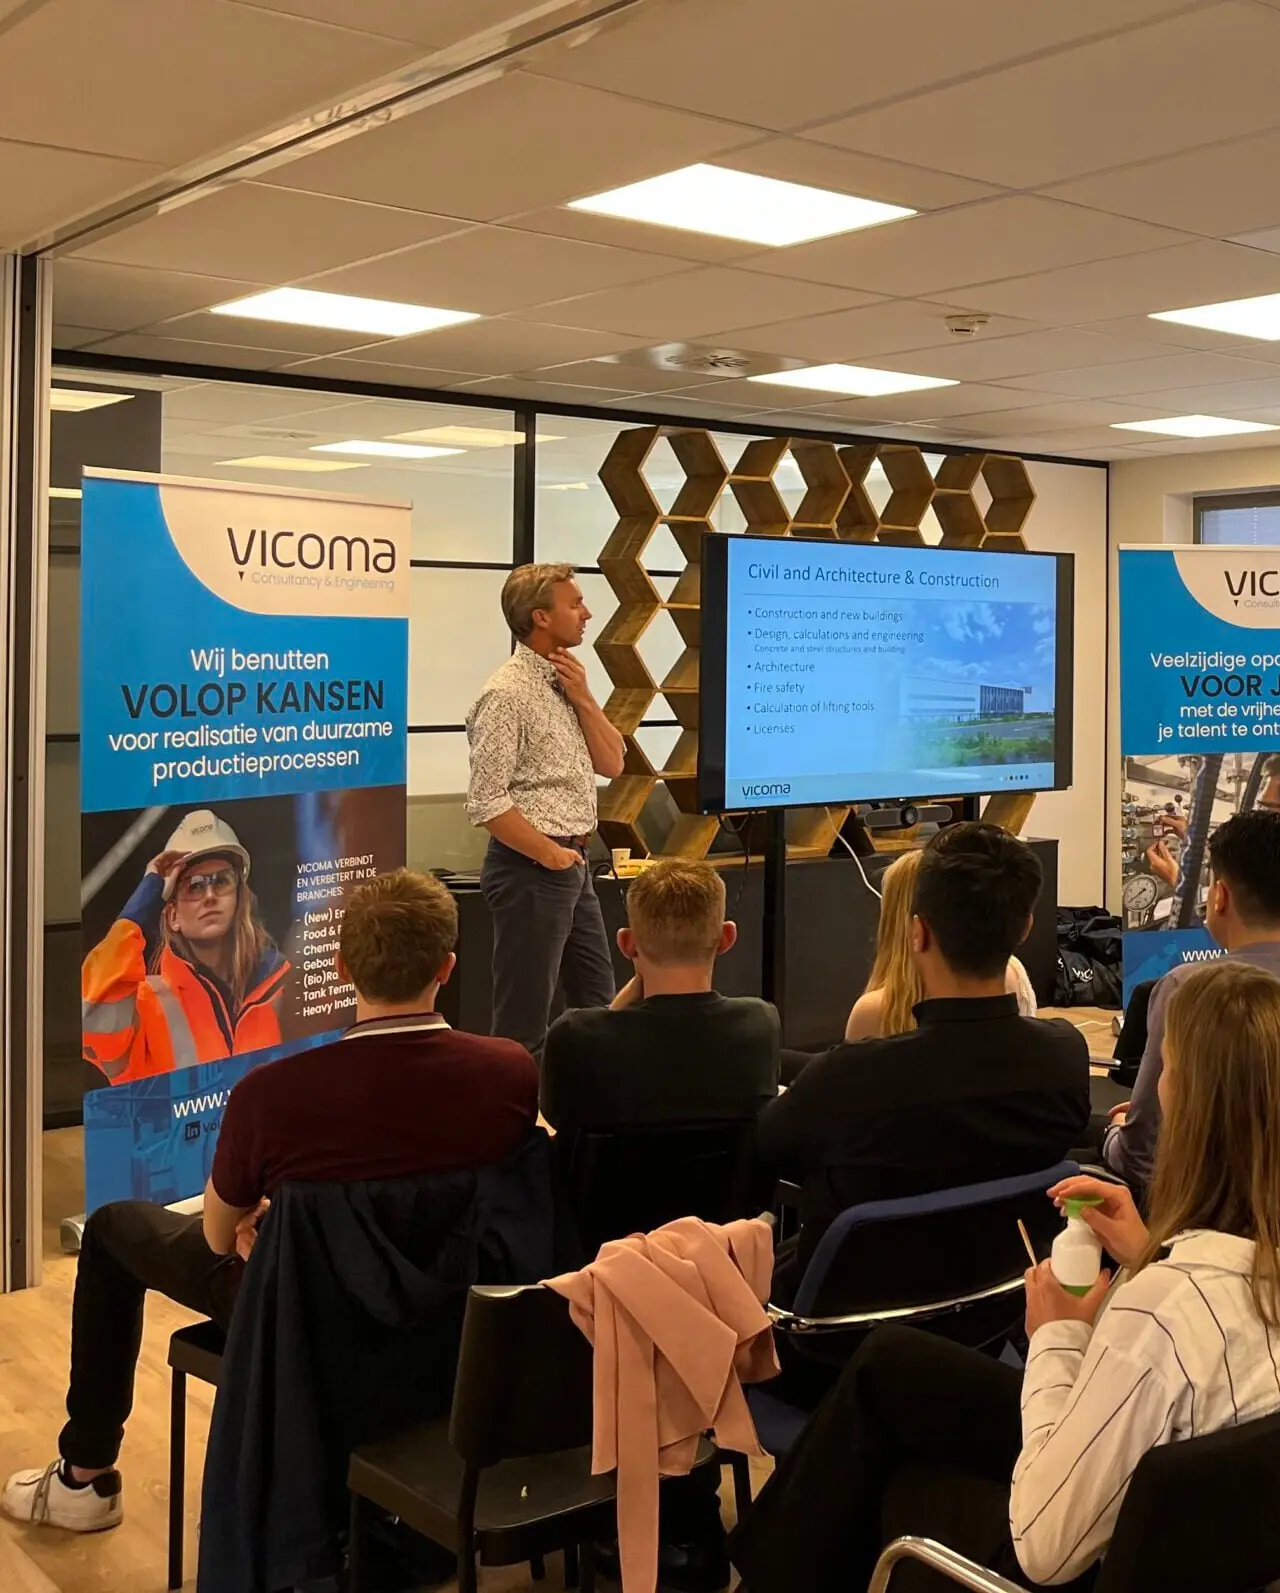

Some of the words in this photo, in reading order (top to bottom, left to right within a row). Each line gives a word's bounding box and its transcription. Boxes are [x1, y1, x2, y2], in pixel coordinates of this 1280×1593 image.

[251, 571, 321, 589] Consultancy
[324, 578, 332, 586] &
[335, 576, 394, 592] Engineering
[748, 564, 779, 579] Civil
[783, 565, 811, 581] and
[815, 567, 901, 584] Architecture
[904, 570, 915, 585] &
[919, 571, 999, 588] Construction
[755, 607, 818, 619] Construction
[820, 609, 838, 620] and
[841, 611, 861, 621] new
[863, 609, 903, 624] buildings
[755, 628, 791, 641] Design,
[793, 628, 849, 640] calculations
[852, 630, 869, 641] and
[871, 631, 925, 643] engineering
[791, 645, 804, 653] and
[191, 648, 225, 678] Wij
[232, 649, 329, 672] benutten
[754, 661, 815, 673] Architecture
[1150, 651, 1246, 672] Veelzijdige
[754, 681, 773, 693] Fire
[775, 682, 805, 695] safety
[1180, 674, 1262, 697] VOOR
[121, 683, 246, 719] VOLOP
[257, 680, 384, 714] KANSEN
[754, 701, 809, 714] Calculation
[811, 700, 821, 713] of
[823, 700, 850, 714] lifting
[852, 700, 875, 712] tools
[1180, 704, 1213, 718] met
[1217, 703, 1237, 717] de
[109, 733, 158, 752] voor
[164, 723, 257, 749] realisatie
[262, 725, 297, 743] van
[302, 720, 392, 741] duurzame
[754, 723, 796, 735] Licenses
[1158, 723, 1173, 743] je
[1177, 722, 1227, 738] talent
[1232, 722, 1248, 736] te
[153, 749, 359, 787] productieprocessen
[297, 861, 333, 874] VICOMA
[335, 854, 374, 868] VERBINDT
[297, 878, 308, 888] EN
[310, 871, 354, 886] VERBETERT
[356, 869, 364, 879] IN
[366, 867, 376, 877] DE
[304, 907, 333, 926] (New)
[303, 926, 326, 941] Food
[328, 926, 336, 935] &
[303, 957, 335, 971] Gebou
[303, 970, 339, 988] (Bio)Ra
[303, 988, 326, 1001] Tank
[328, 983, 355, 996] Termi
[303, 1002, 333, 1017] Heavy
[334, 997, 358, 1010] Indus
[173, 1089, 231, 1119] www.
